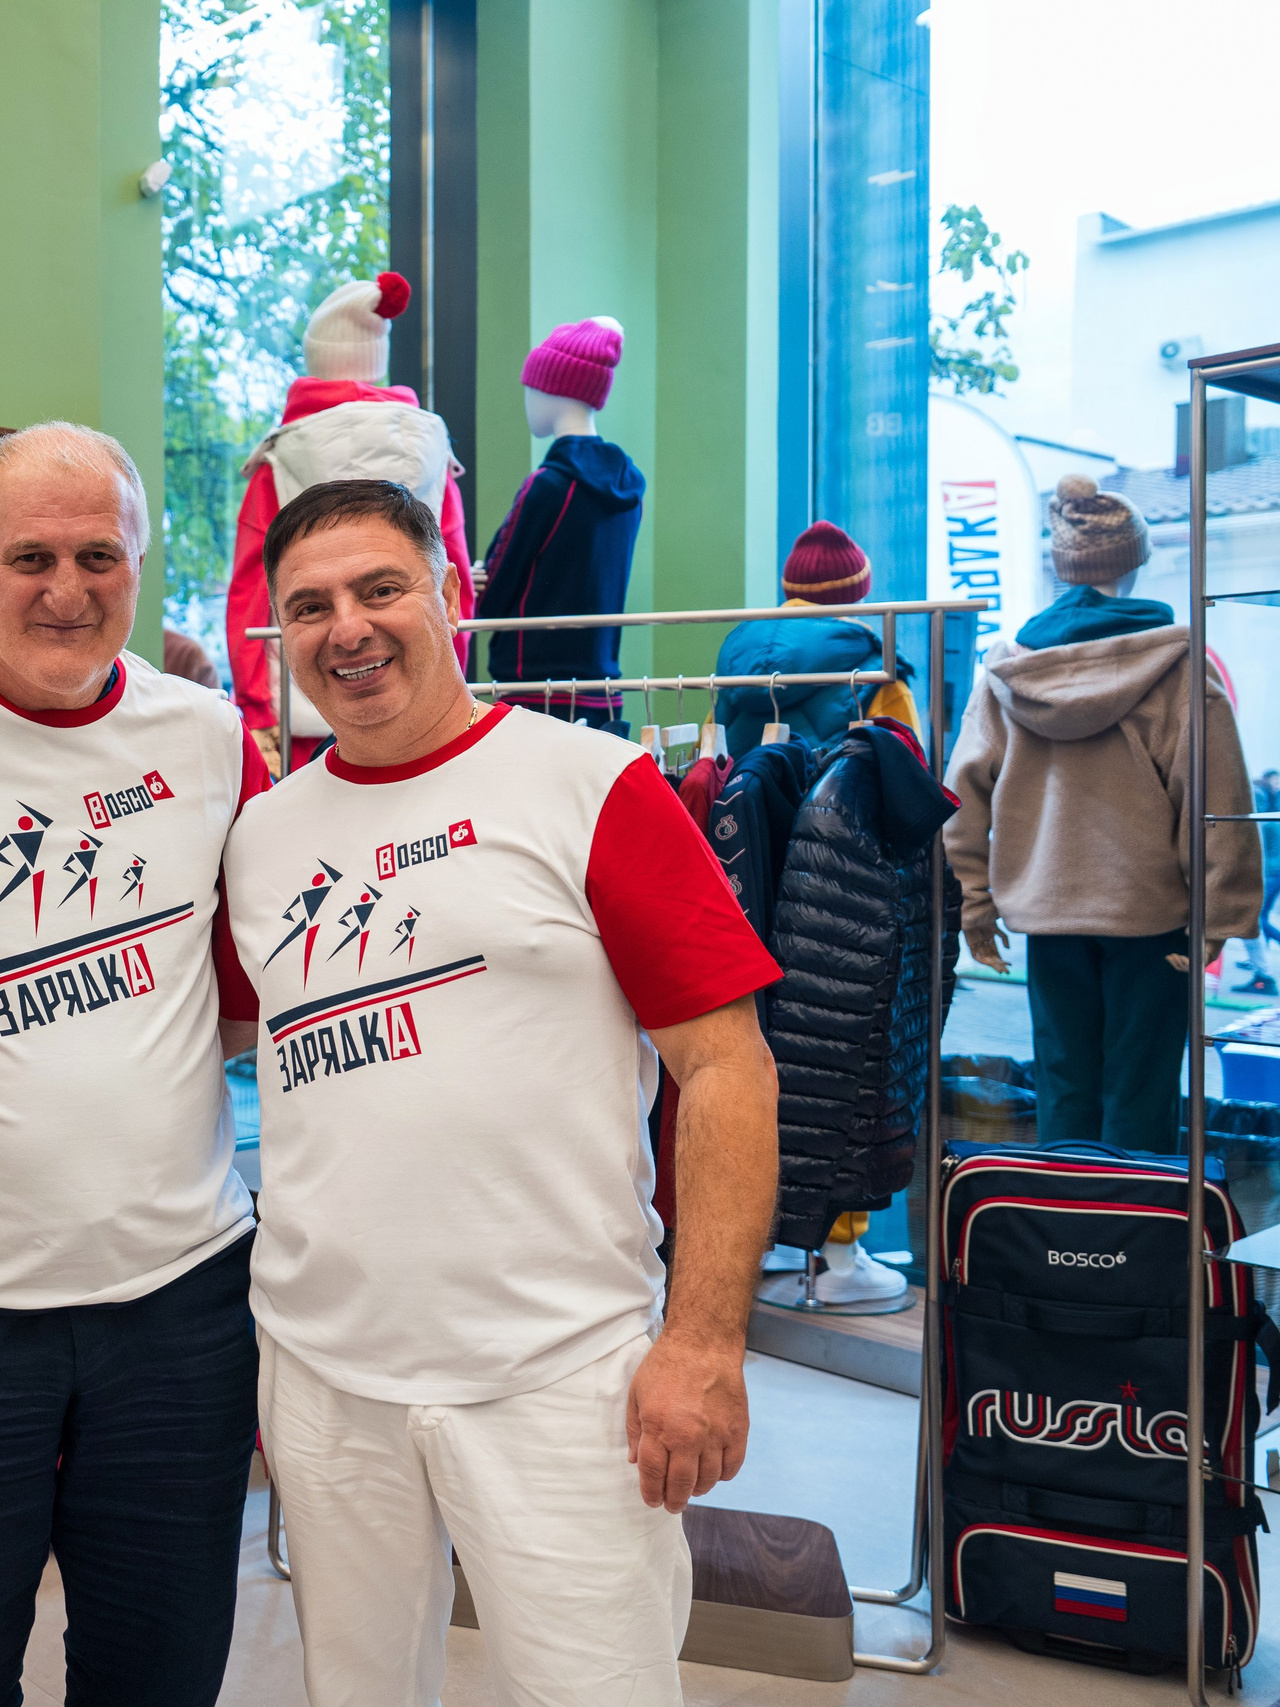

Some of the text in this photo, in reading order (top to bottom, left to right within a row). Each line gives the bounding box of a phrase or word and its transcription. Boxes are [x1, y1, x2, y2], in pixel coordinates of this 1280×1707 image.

[82, 783, 154, 829] BOSCO
[375, 833, 449, 881] BOSCO
[276, 1002, 422, 1093] ЗАРЯДКА
[1047, 1250, 1116, 1268] BOSCO
[967, 1380, 1210, 1464] russia
